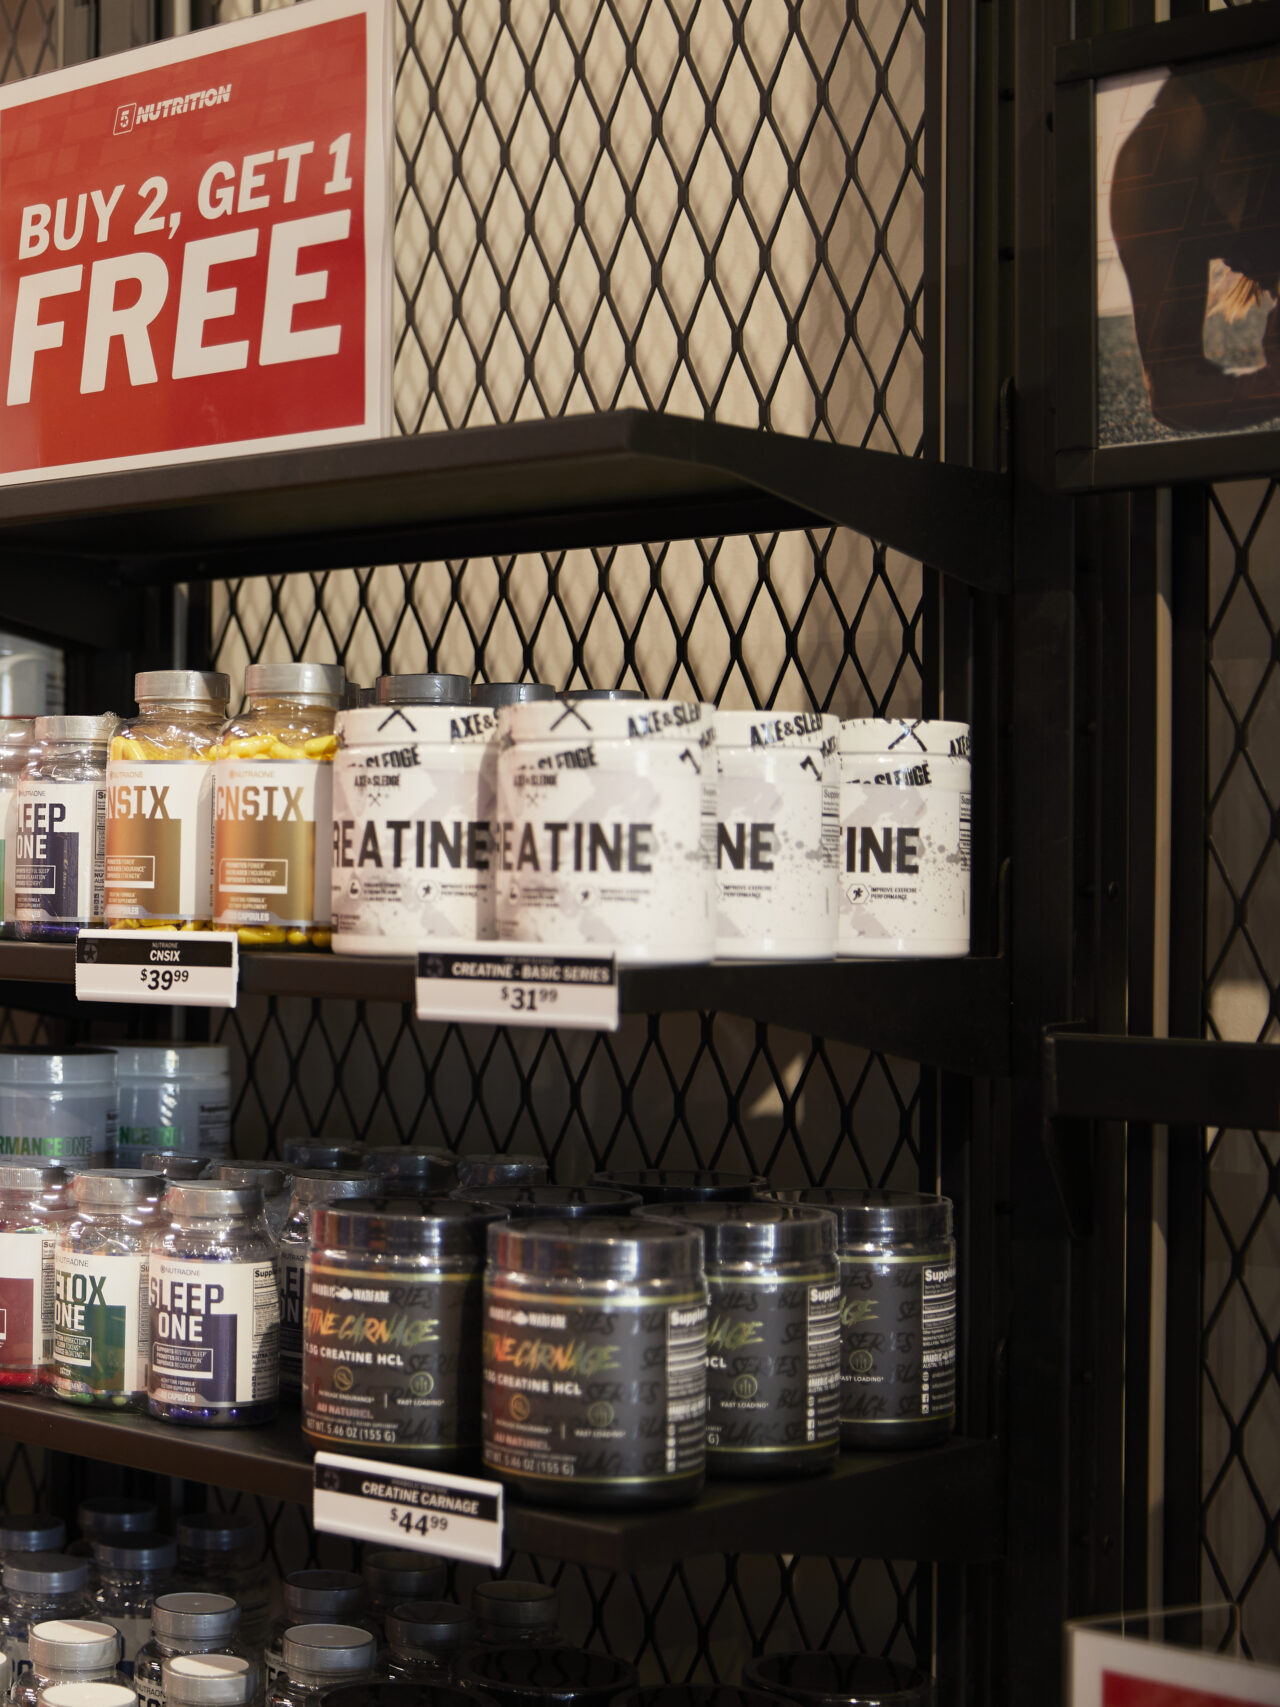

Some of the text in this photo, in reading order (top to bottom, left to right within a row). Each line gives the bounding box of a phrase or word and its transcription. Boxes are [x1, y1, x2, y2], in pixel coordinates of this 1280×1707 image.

[136, 84, 232, 125] NUTRITION
[18, 132, 352, 260] BUY 2, GET 1
[6, 209, 352, 406] FREE
[216, 786, 304, 821] CNSIX
[16, 835, 47, 859] ONE
[717, 822, 775, 870] NE
[846, 827, 920, 873] INE
[150, 950, 181, 962] CNSIX
[452, 961, 512, 979] CREATINE
[521, 963, 560, 980] BASIC
[562, 965, 609, 983] SERIES
[149, 1277, 224, 1314] SLEEP
[55, 1301, 85, 1330] ONE
[158, 1312, 203, 1341] ONE
[320, 1346, 404, 1366] CREATINE HCL
[498, 1372, 583, 1396] CREATINE HCL
[327, 1423, 344, 1436] 5.46
[346, 1427, 358, 1438] OZ
[359, 1427, 381, 1441] (155
[383, 1431, 397, 1443] G)
[361, 1481, 480, 1515] CREATINE CARNAGE
